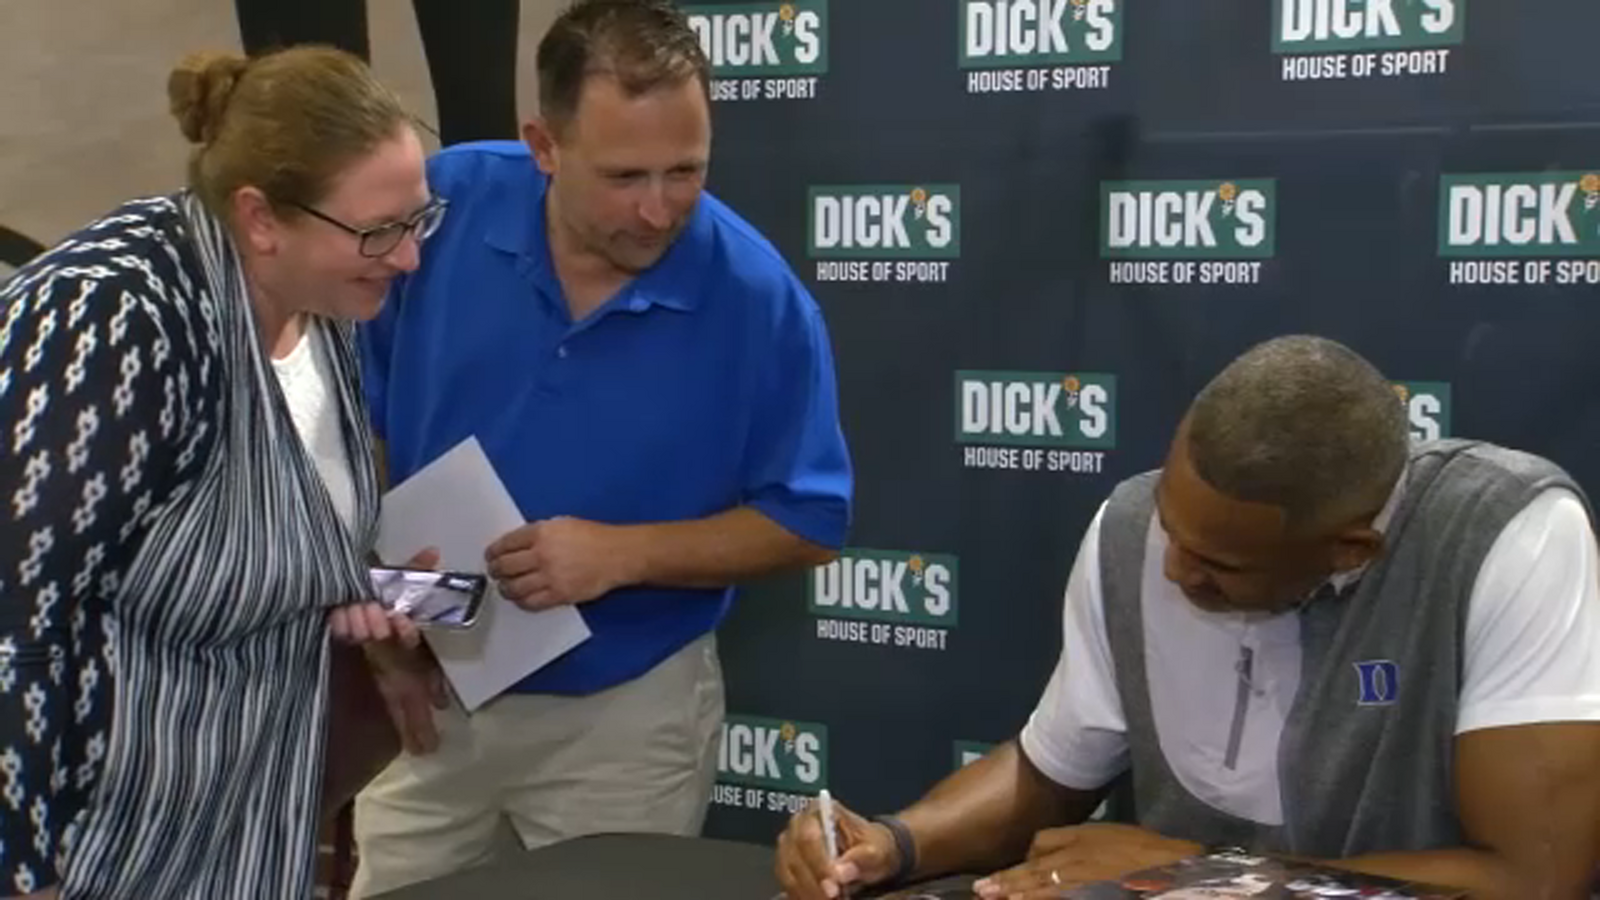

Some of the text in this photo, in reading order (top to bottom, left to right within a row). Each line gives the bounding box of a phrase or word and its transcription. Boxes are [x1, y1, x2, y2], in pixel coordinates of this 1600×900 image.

[966, 0, 1114, 58] DICK'S
[968, 66, 1111, 93] HOUSE OF SPORT
[1282, 49, 1449, 80] HOUSE OF SPORT
[709, 77, 817, 101] USE OF SPORT
[814, 188, 953, 249] DICK'S
[1108, 182, 1266, 249] DICK'S
[1448, 174, 1600, 246] DICK'
[816, 261, 949, 282] HOUSE OF SPORT
[1109, 262, 1261, 283] HOUSE OF SPORT
[1450, 261, 1600, 284] HOUSE OF SPO
[962, 376, 1107, 438] DICK'S
[964, 447, 1105, 473] HOUSE OF SPORT
[814, 554, 950, 617] DICK'S
[816, 619, 949, 650] HOUSE OF SPORT
[1354, 660, 1399, 706] D
[717, 722, 821, 784] ICK'S
[746, 788, 764, 809] OF
